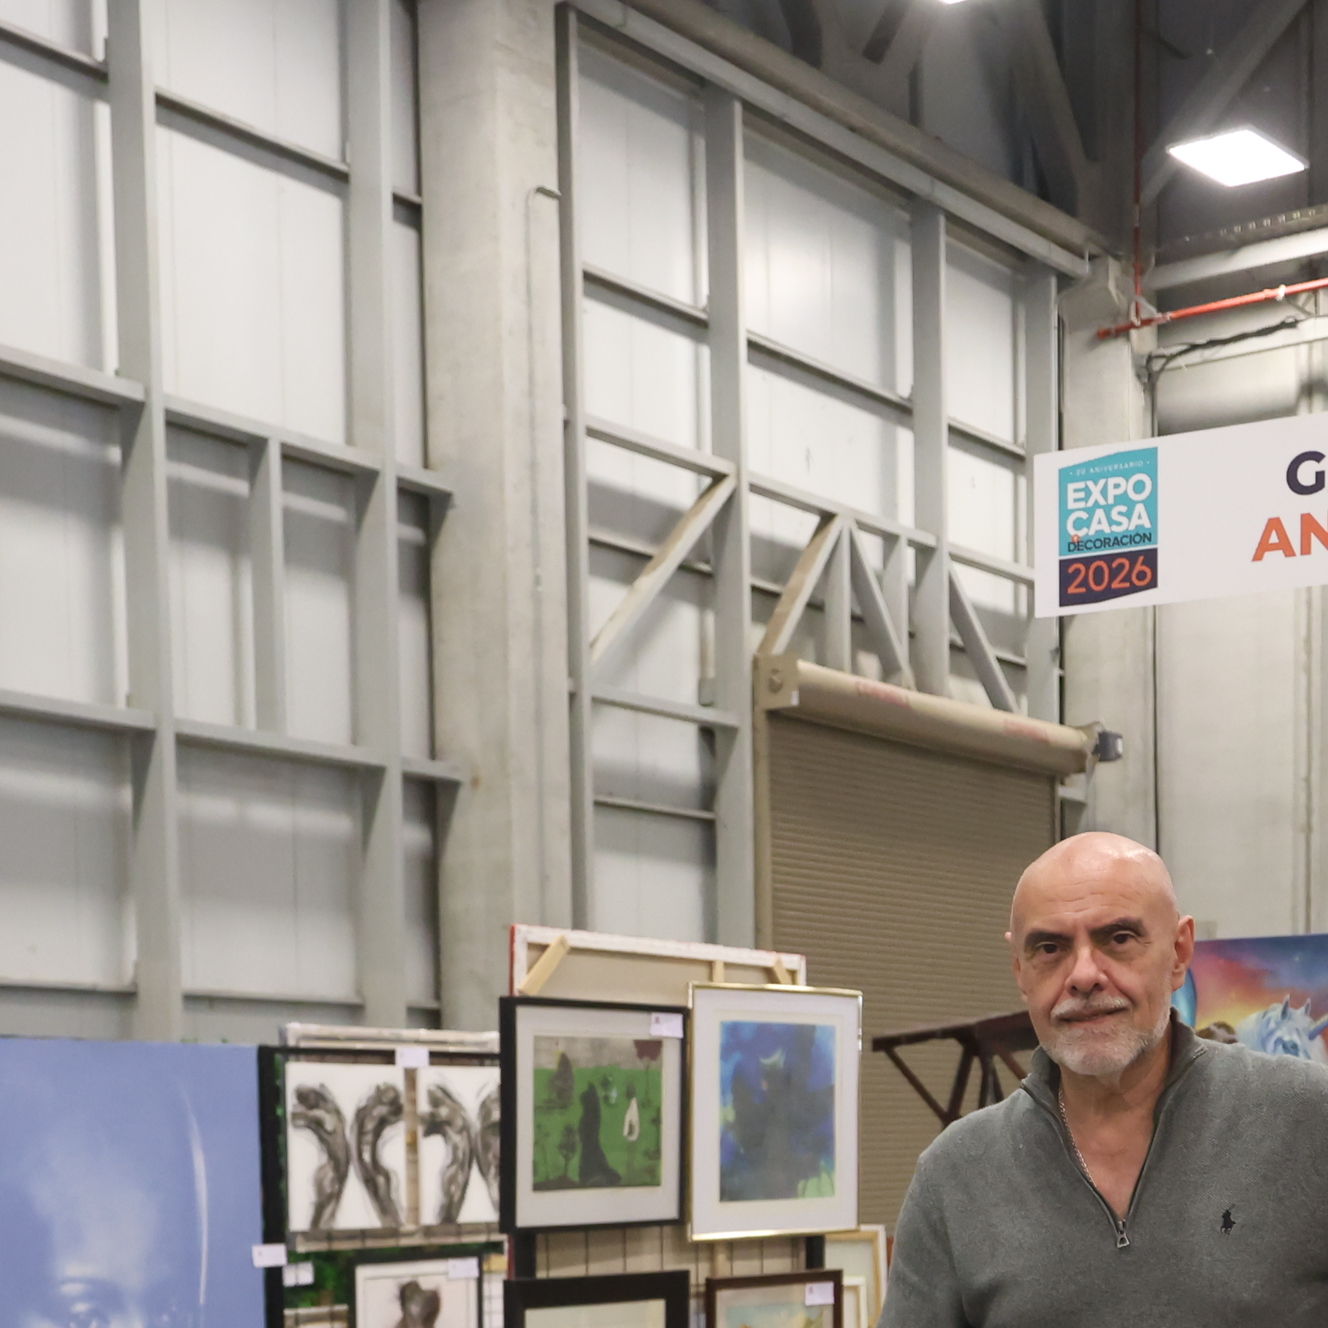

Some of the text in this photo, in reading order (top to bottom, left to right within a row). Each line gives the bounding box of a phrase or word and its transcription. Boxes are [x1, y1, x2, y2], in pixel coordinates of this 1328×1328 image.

[1066, 472, 1152, 510] EXPO
[1066, 502, 1152, 538] CASA
[1067, 555, 1153, 594] 2026
